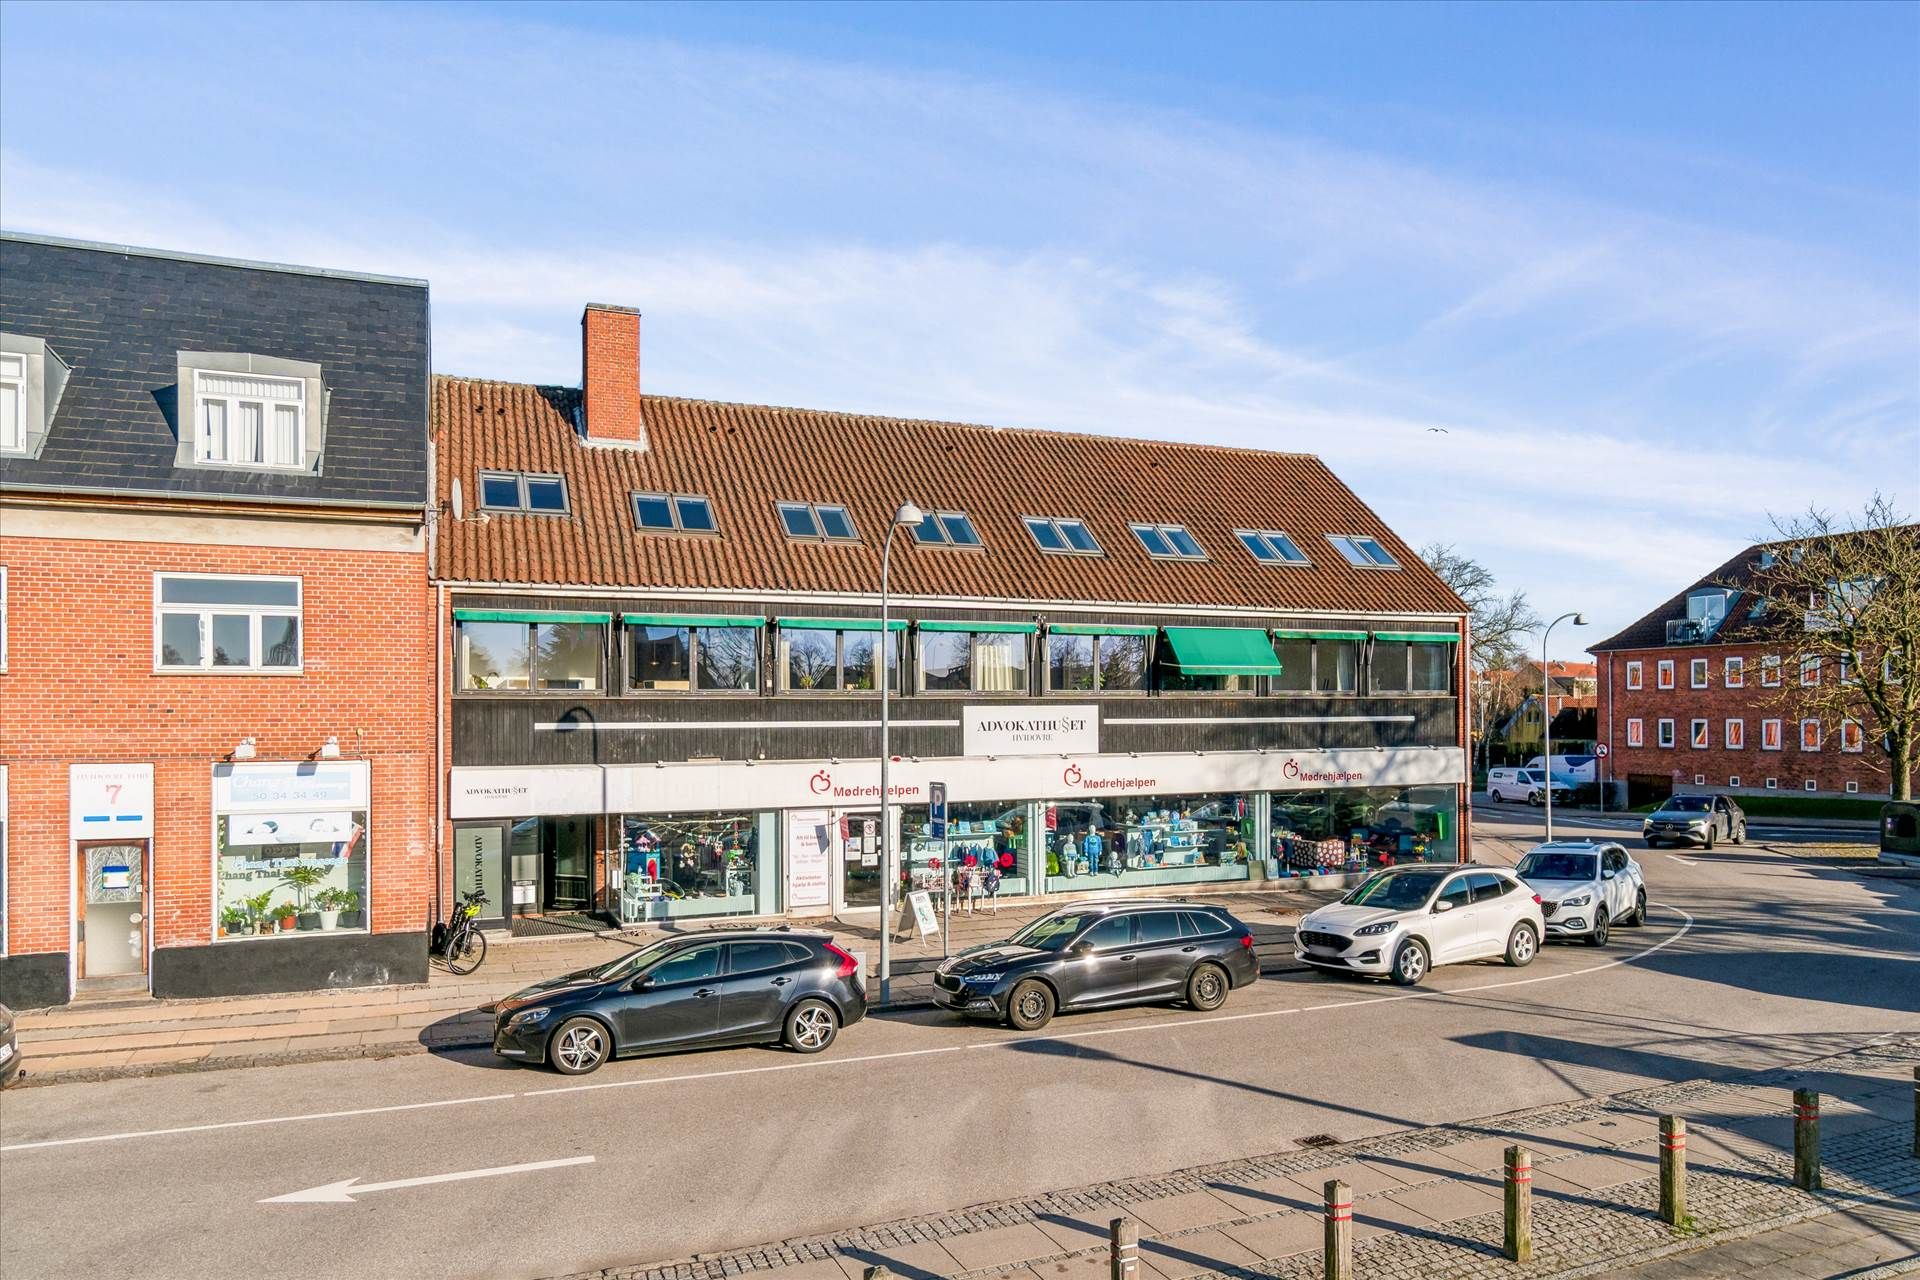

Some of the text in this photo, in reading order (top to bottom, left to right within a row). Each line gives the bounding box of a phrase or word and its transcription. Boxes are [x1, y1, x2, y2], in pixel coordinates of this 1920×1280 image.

[1012, 733, 1053, 742] HVIDOVRE
[1299, 771, 1362, 783] Mødrehjælpen
[1083, 778, 1156, 790] Mødrehjælpen
[105, 784, 122, 805] 7
[272, 792, 287, 800] 34
[293, 791, 307, 799] 34
[934, 790, 943, 815] P
